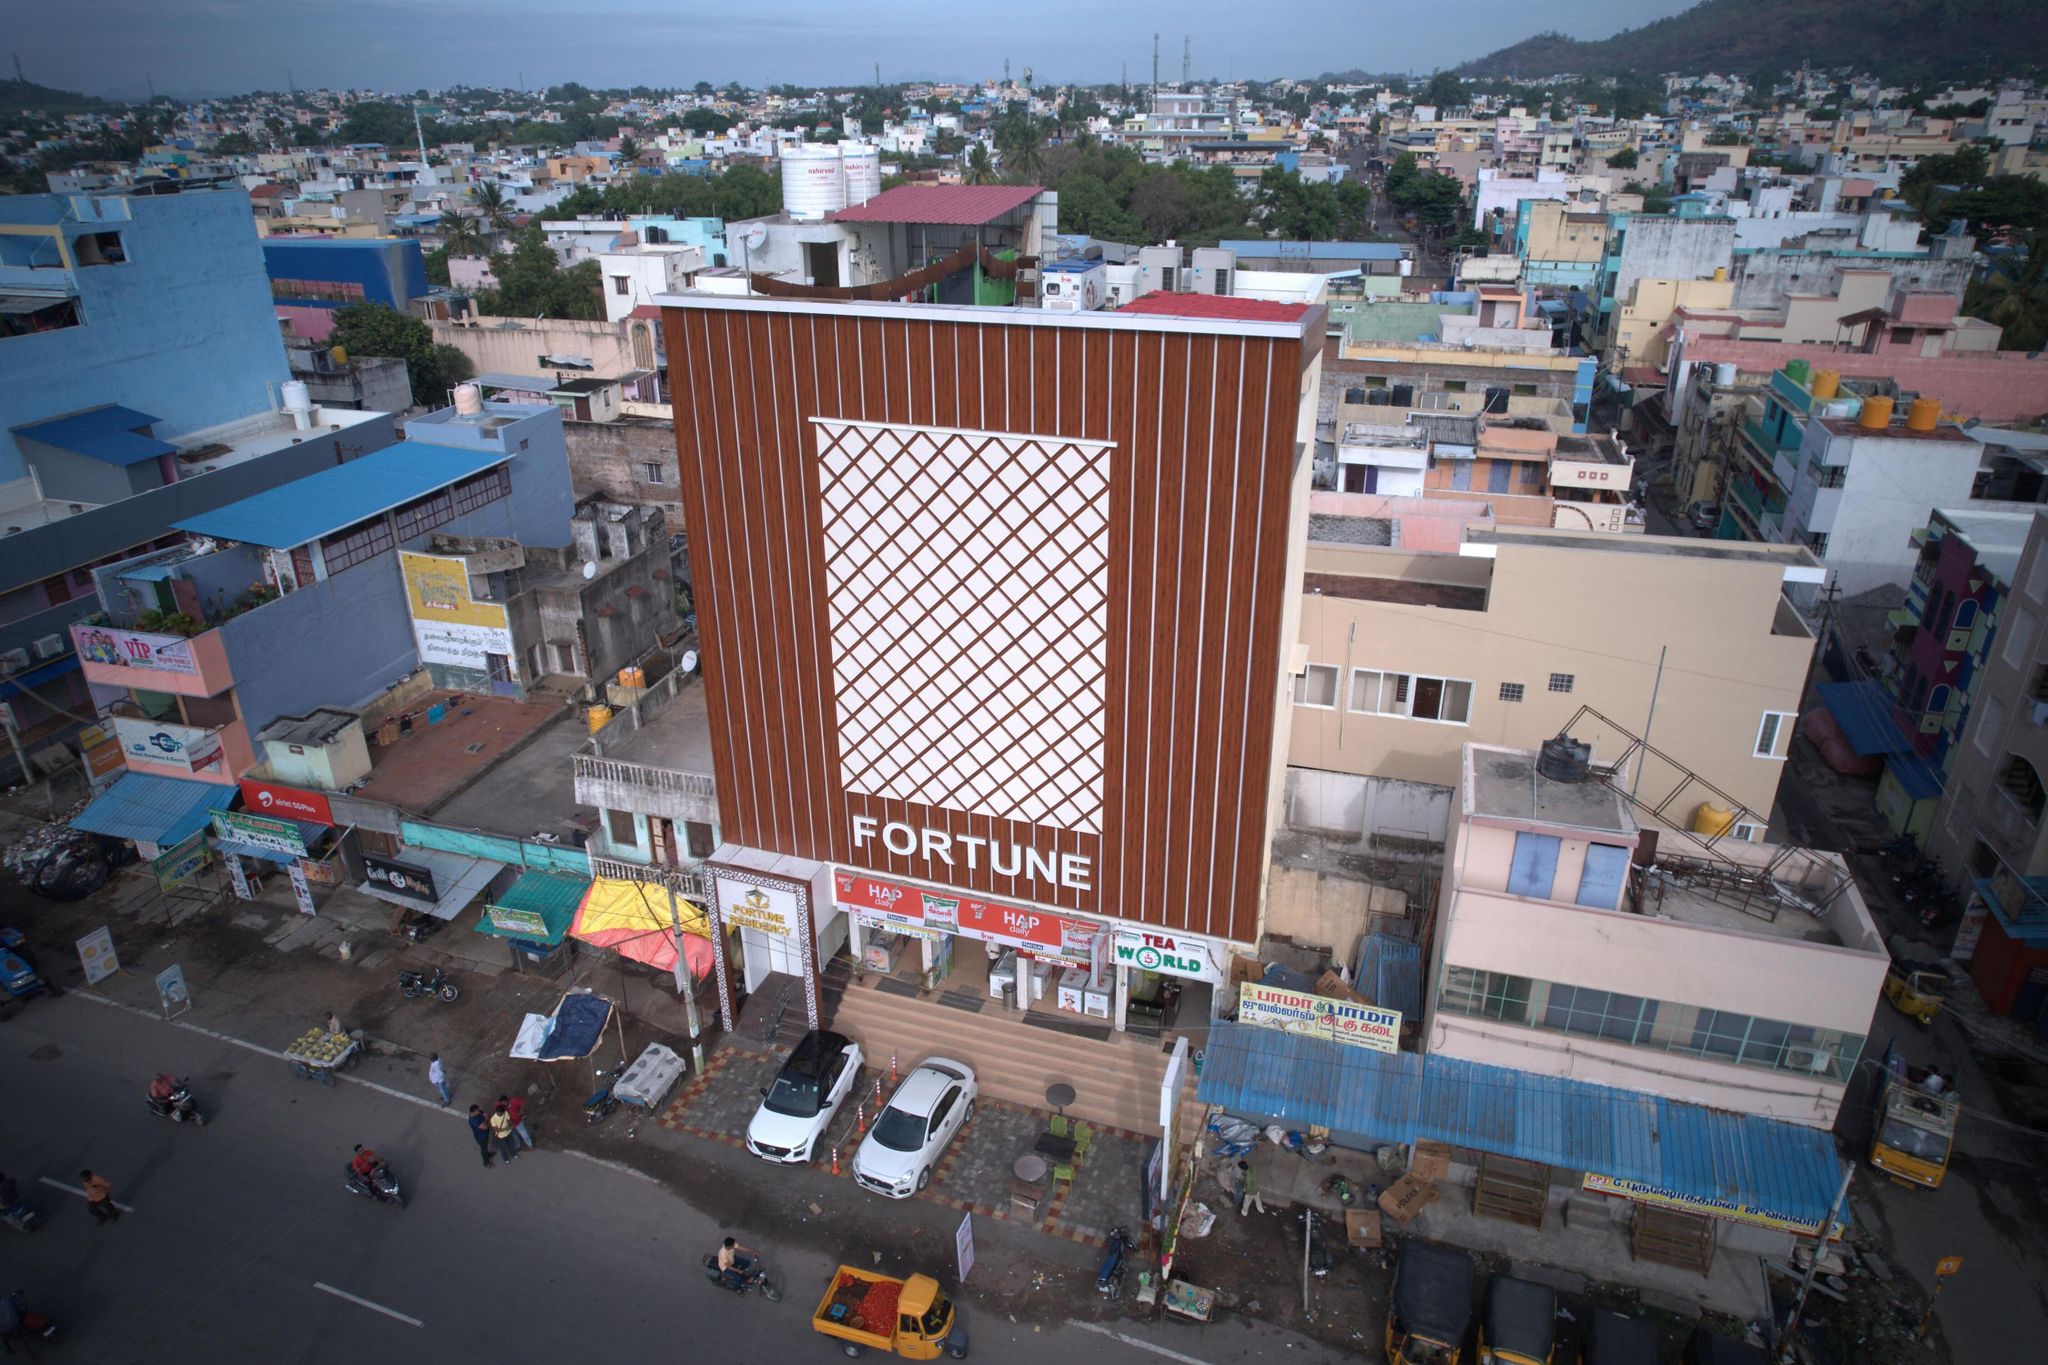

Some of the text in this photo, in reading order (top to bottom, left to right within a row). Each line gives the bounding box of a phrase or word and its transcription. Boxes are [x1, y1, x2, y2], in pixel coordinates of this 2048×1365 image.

[123, 640, 151, 659] VIP
[275, 798, 292, 808] airtel
[853, 815, 1092, 891] FORTUNE
[868, 884, 903, 901] HAP
[874, 898, 894, 910] daily
[732, 904, 785, 925] FORTUNE
[1003, 911, 1040, 929] HAP
[728, 914, 792, 936] RESIDENCY
[1009, 924, 1031, 937] daily
[1142, 933, 1176, 951] TEA
[1117, 945, 1202, 973] WORLD
[1257, 990, 1314, 1010] பாமா
[1327, 1003, 1397, 1026] பாமா
[1320, 1014, 1358, 1032] அடகு
[1360, 1022, 1394, 1038] கடை
